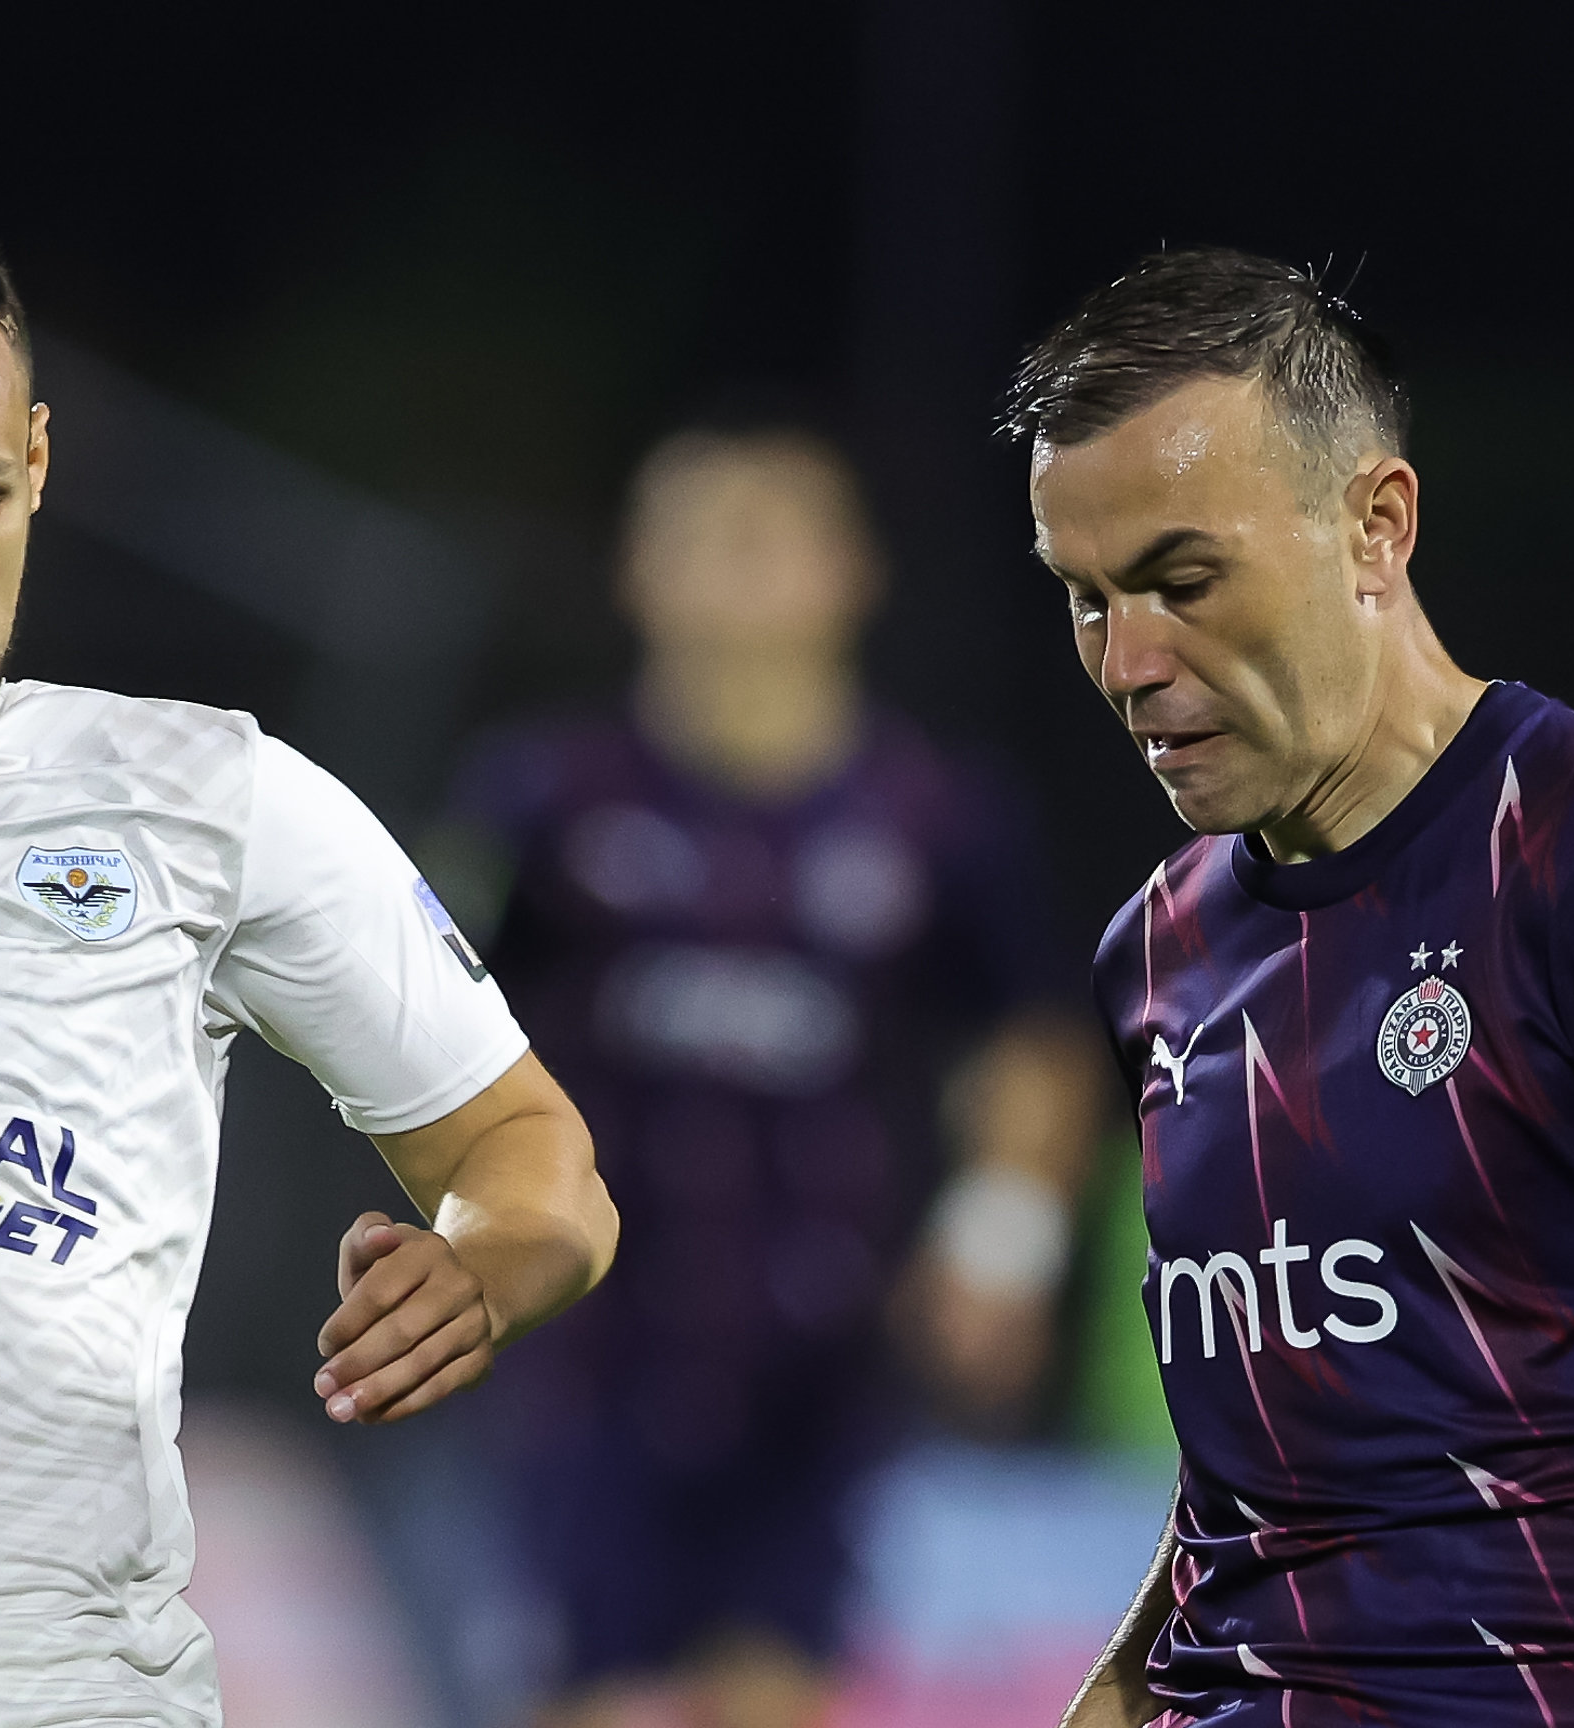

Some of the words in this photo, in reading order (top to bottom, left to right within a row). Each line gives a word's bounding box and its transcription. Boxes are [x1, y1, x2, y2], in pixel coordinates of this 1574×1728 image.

[1382, 997, 1413, 1080] PARTIZAN
[1407, 1053, 1434, 1066] KLUB
[1160, 1218, 1399, 1364] mts
